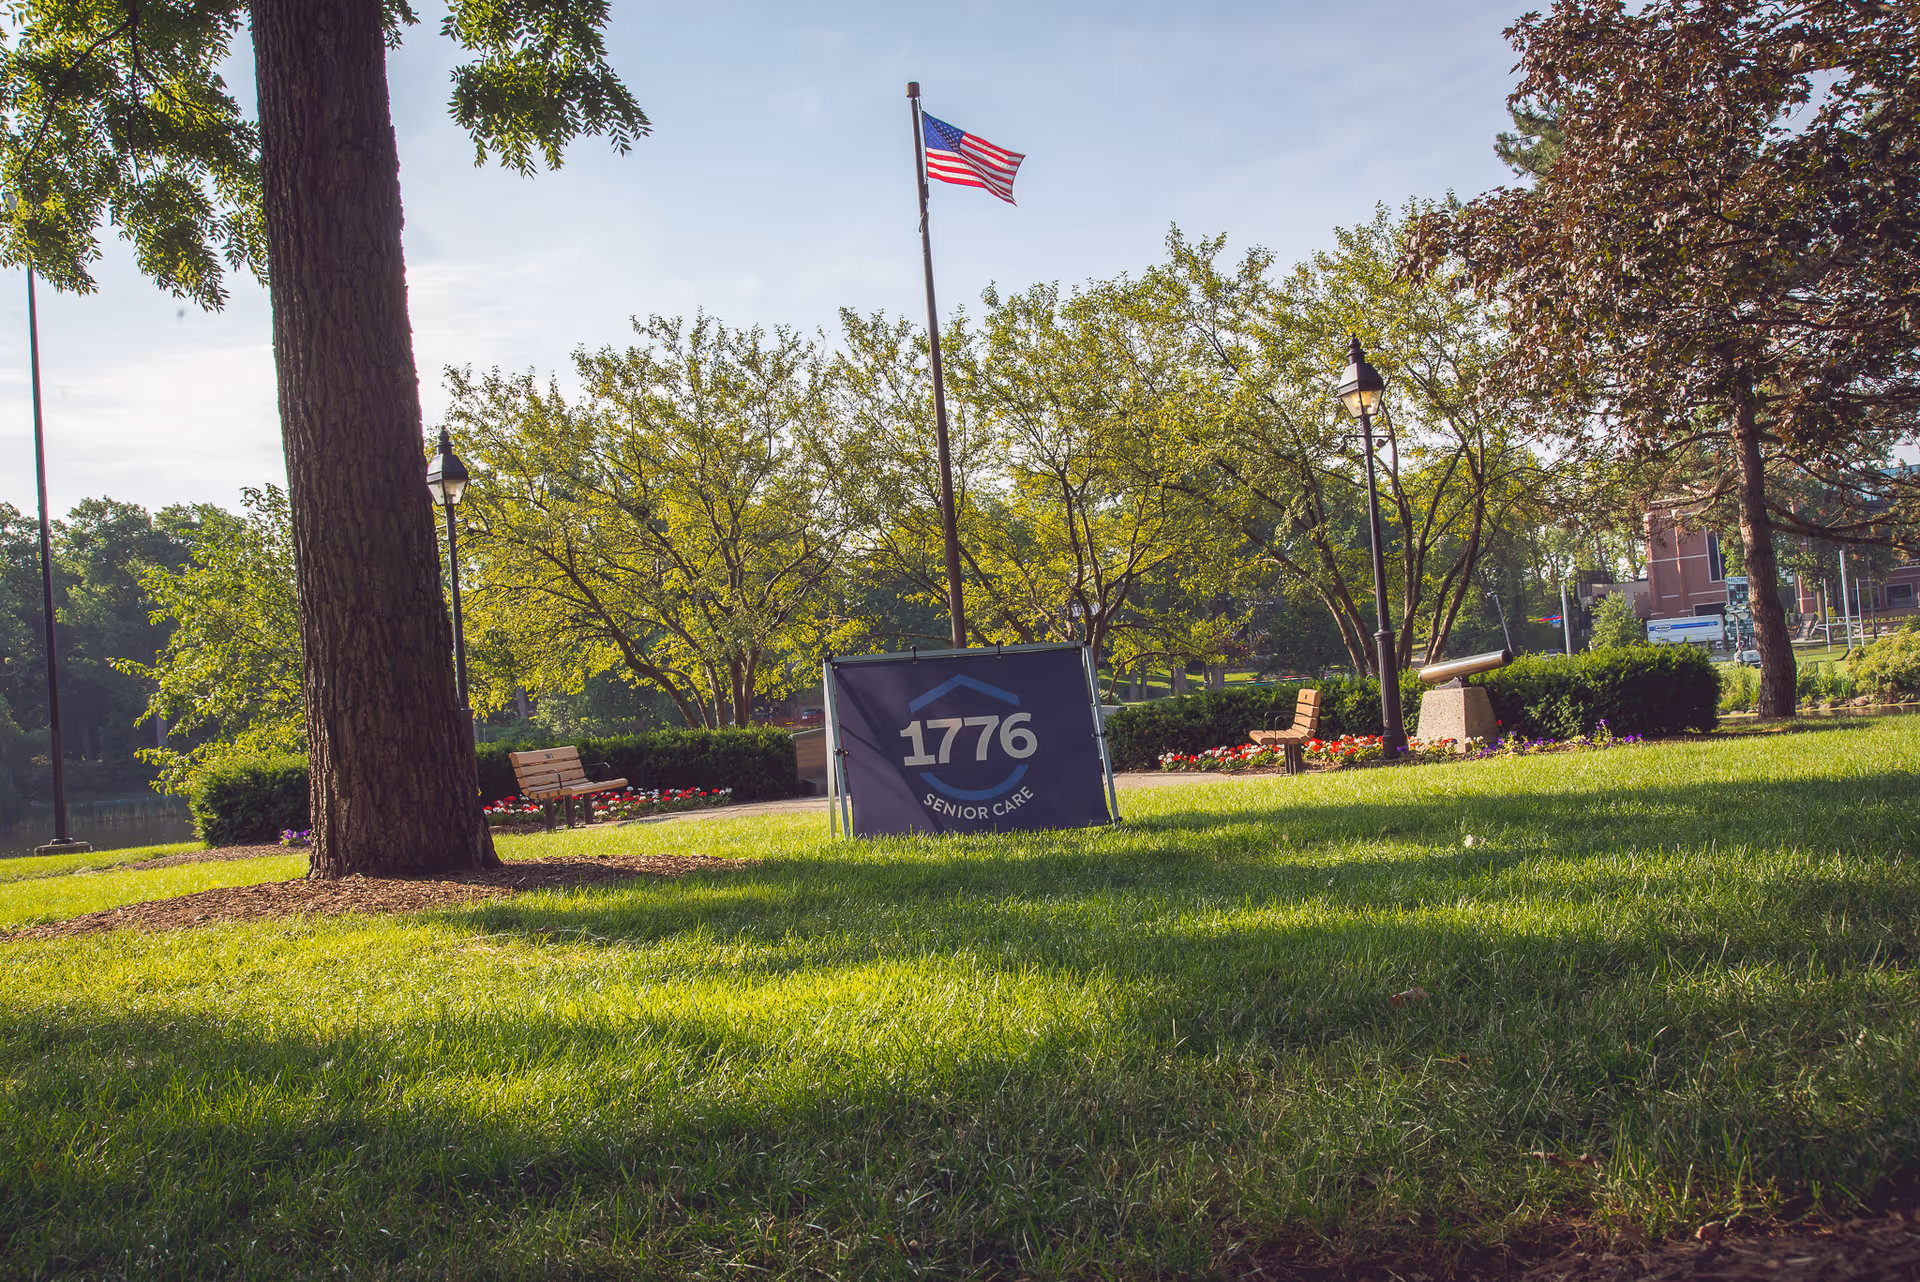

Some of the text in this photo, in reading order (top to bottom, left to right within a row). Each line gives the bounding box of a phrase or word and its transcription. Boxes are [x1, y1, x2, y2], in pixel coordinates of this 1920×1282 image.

[900, 712, 1038, 766] 1776
[923, 786, 1034, 820] SENIOR CARE
